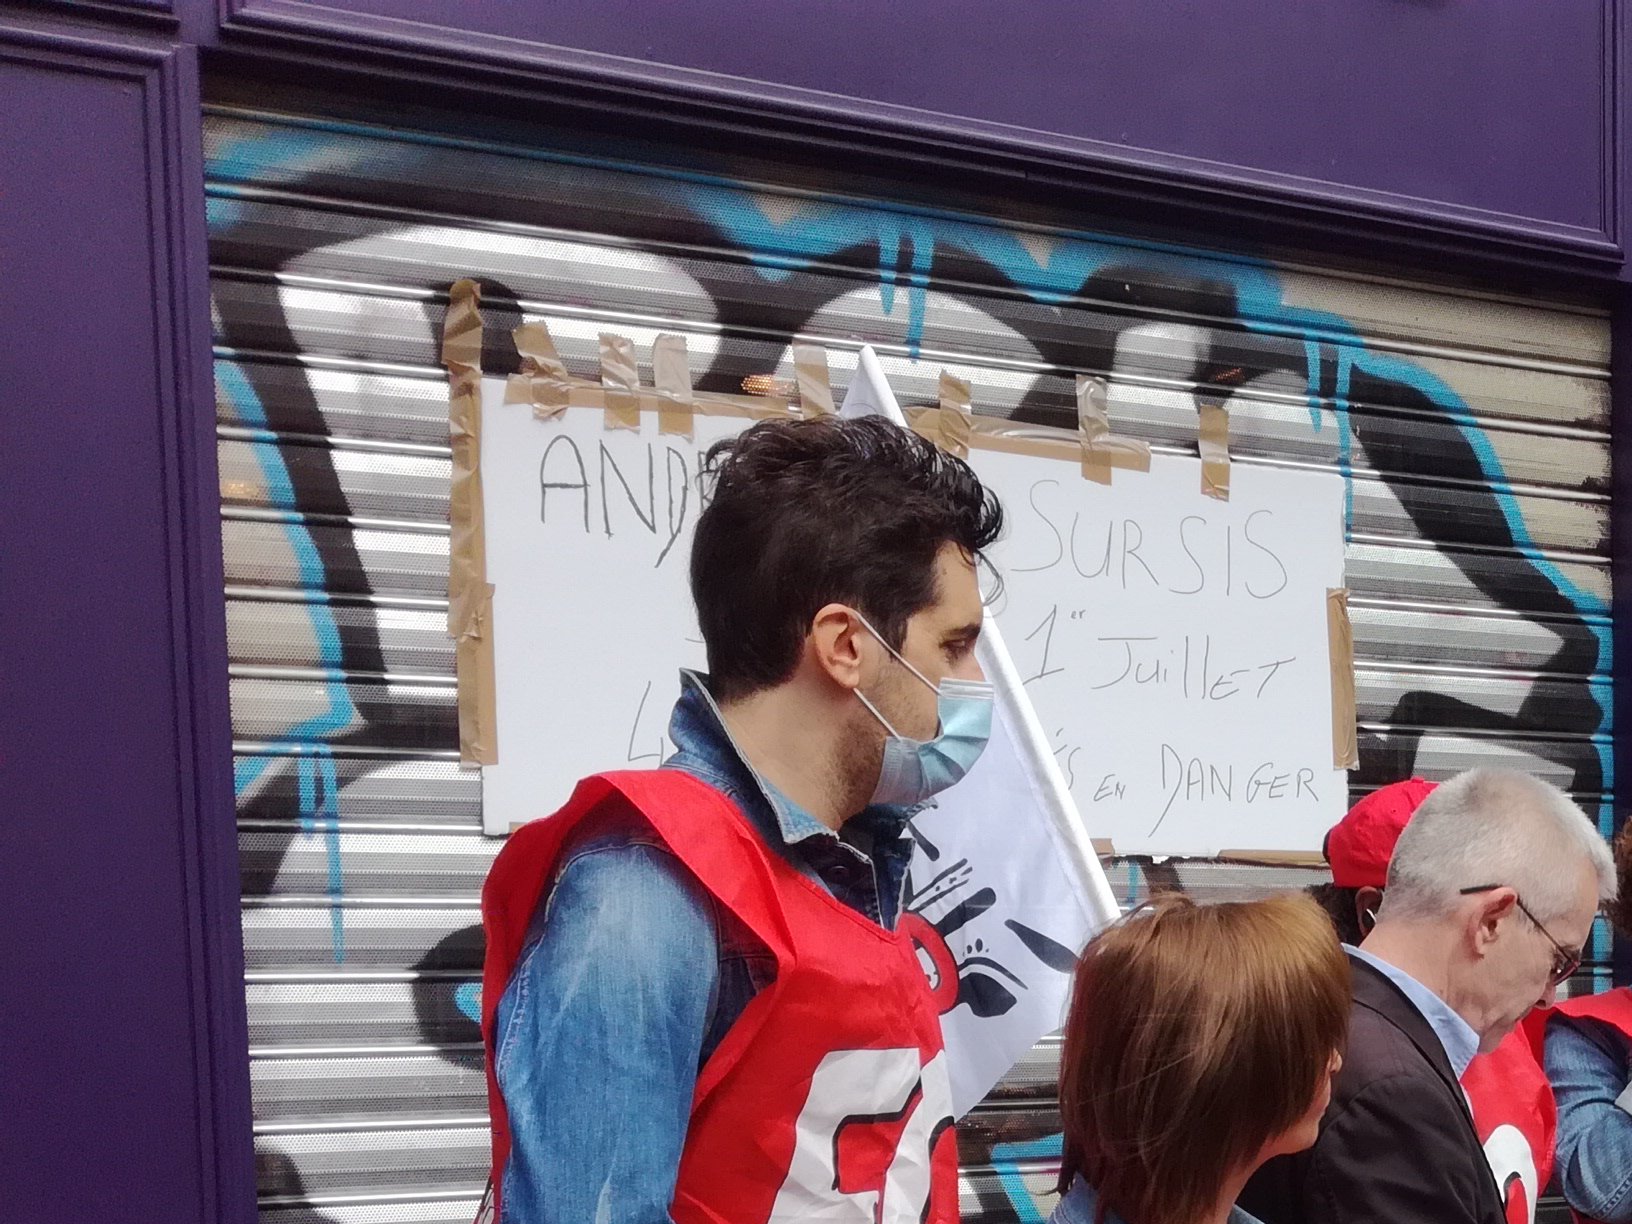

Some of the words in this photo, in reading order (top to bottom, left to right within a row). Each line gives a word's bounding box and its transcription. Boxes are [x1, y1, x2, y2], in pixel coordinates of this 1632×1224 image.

[539, 434, 718, 568] ANDR
[1010, 479, 1288, 599] SURSIS
[1148, 742, 1320, 839] DANGER
